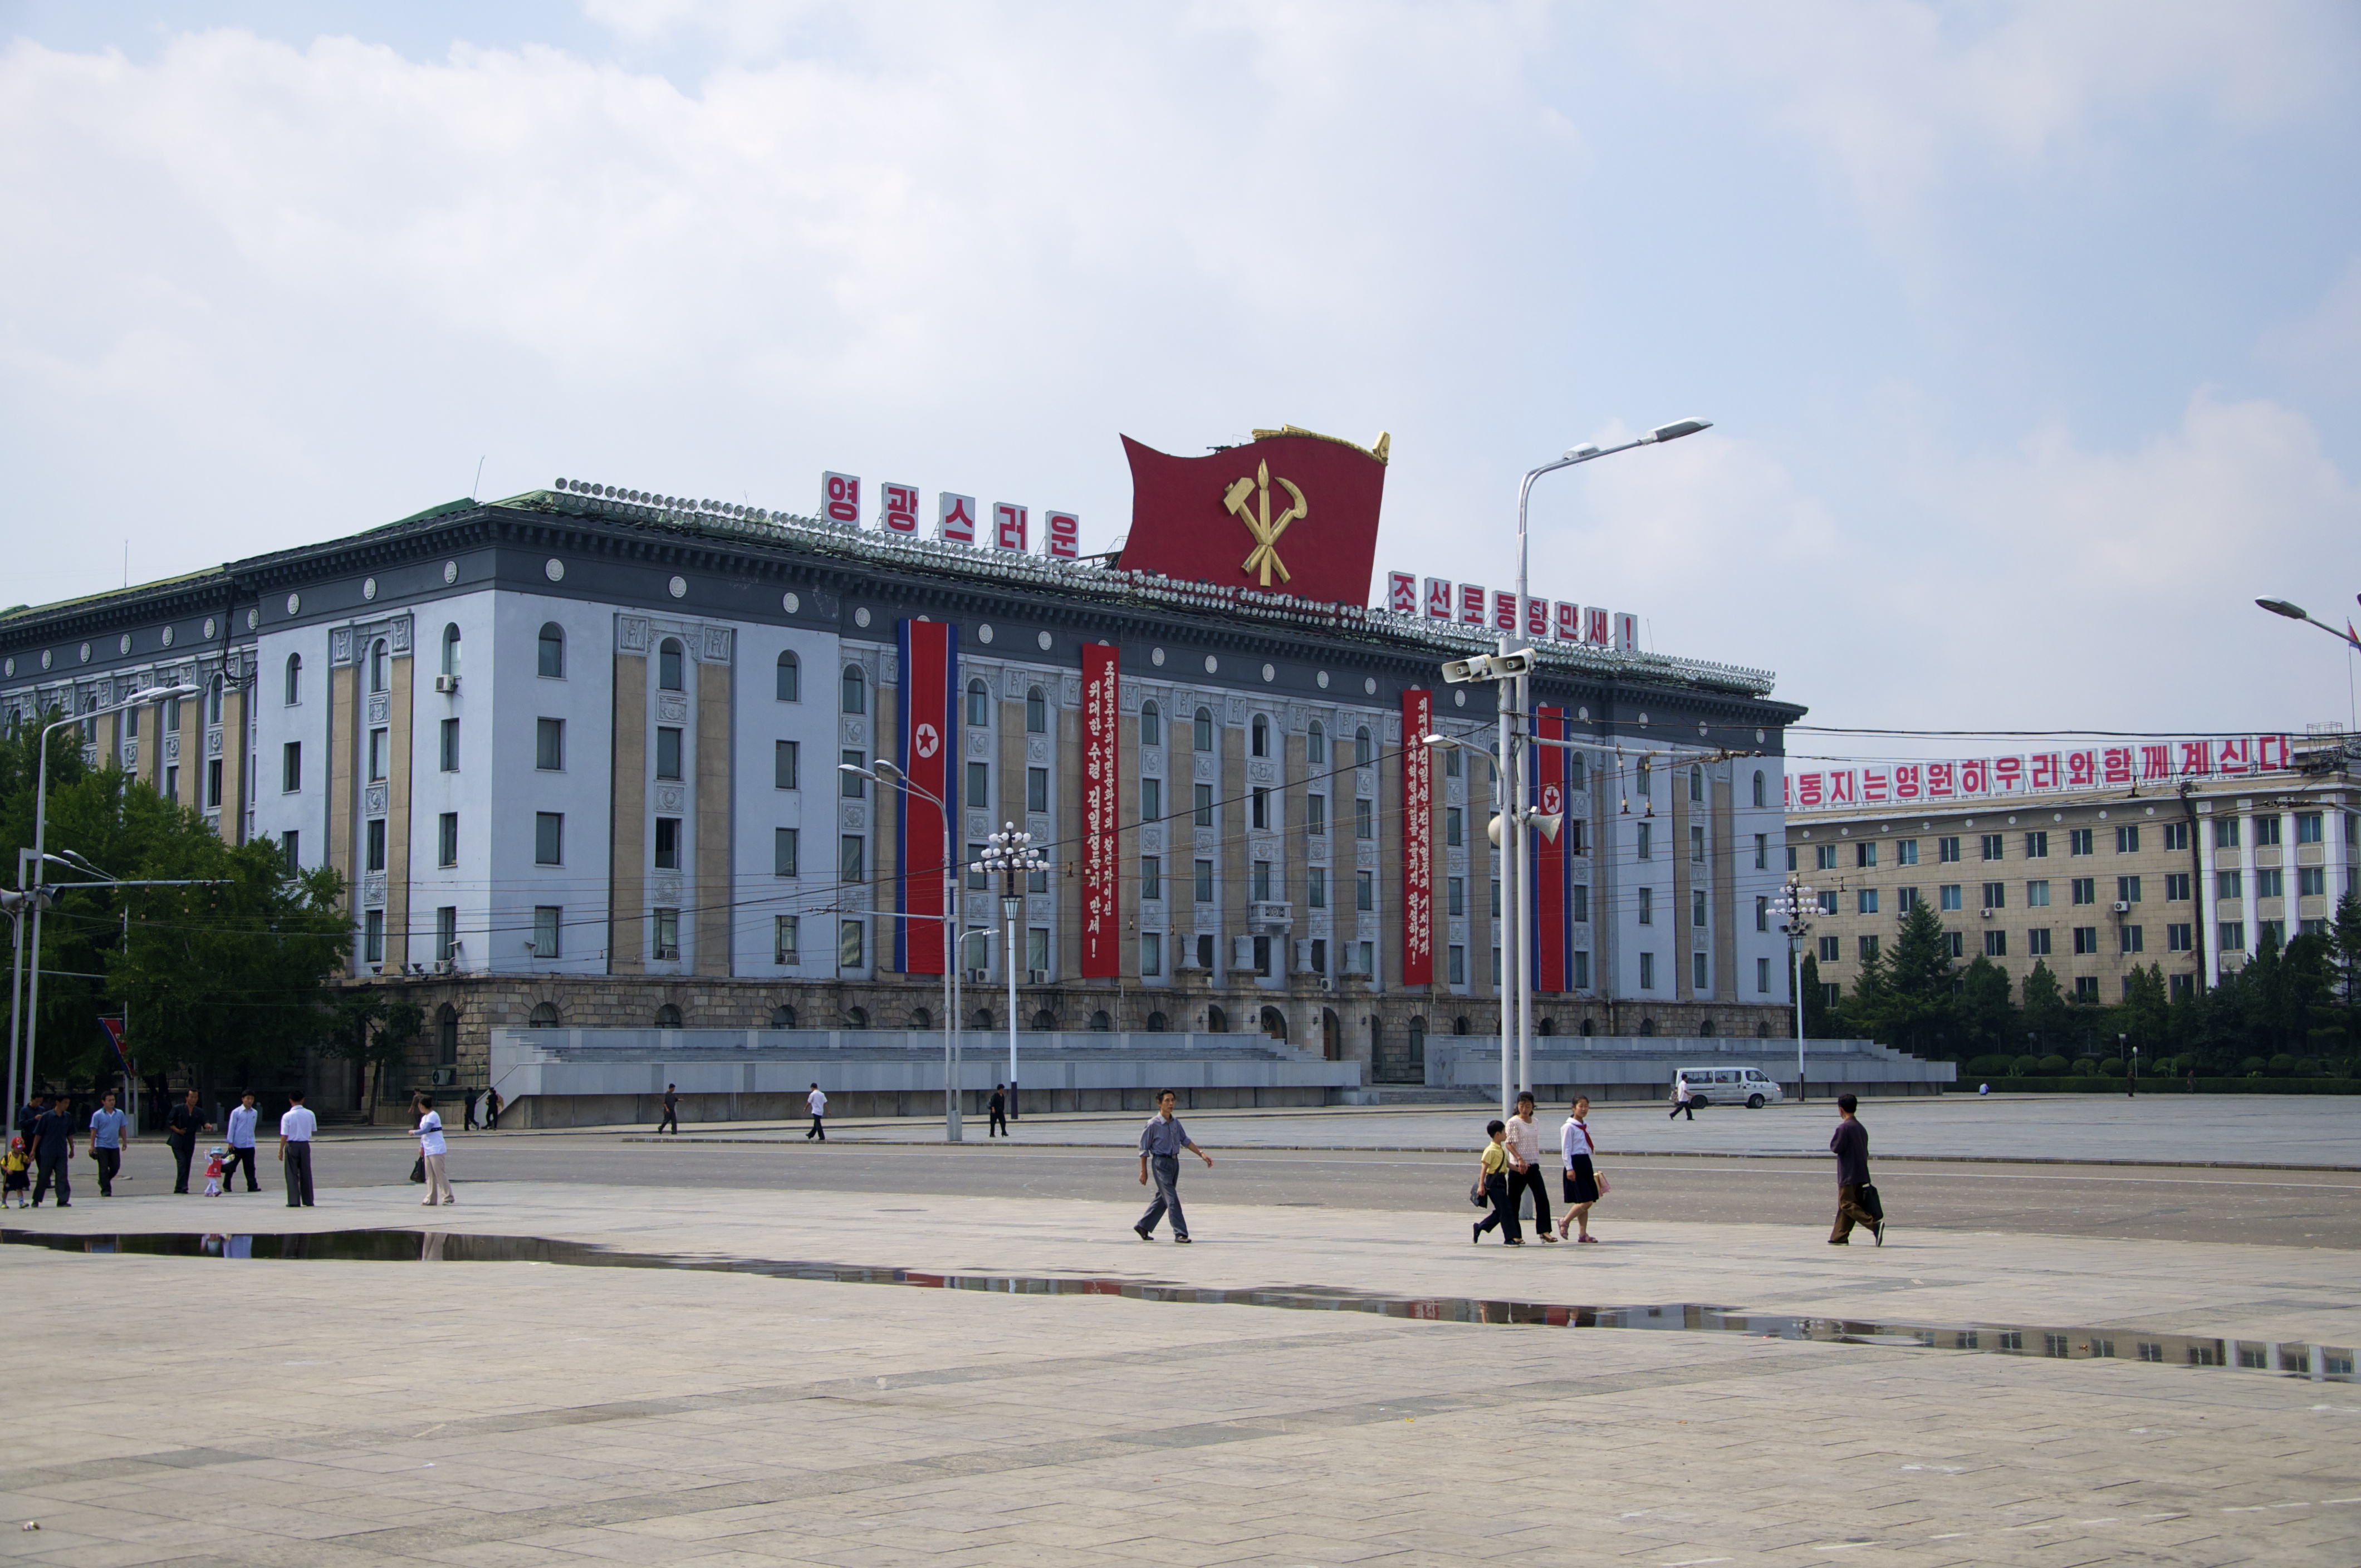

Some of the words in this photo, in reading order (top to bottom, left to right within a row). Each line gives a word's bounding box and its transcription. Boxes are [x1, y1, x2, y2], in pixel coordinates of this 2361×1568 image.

[828, 477, 1077, 557] 영광스러운
[1088, 680, 1101, 736] 위대한
[1104, 660, 1115, 829] 조선민주주의인민공화국의
[1088, 742, 1101, 780] 수령
[1103, 835, 1114, 916] 창건자이신
[1088, 895, 1101, 958] 만세!
[1408, 891, 1419, 965] 완성하자!
